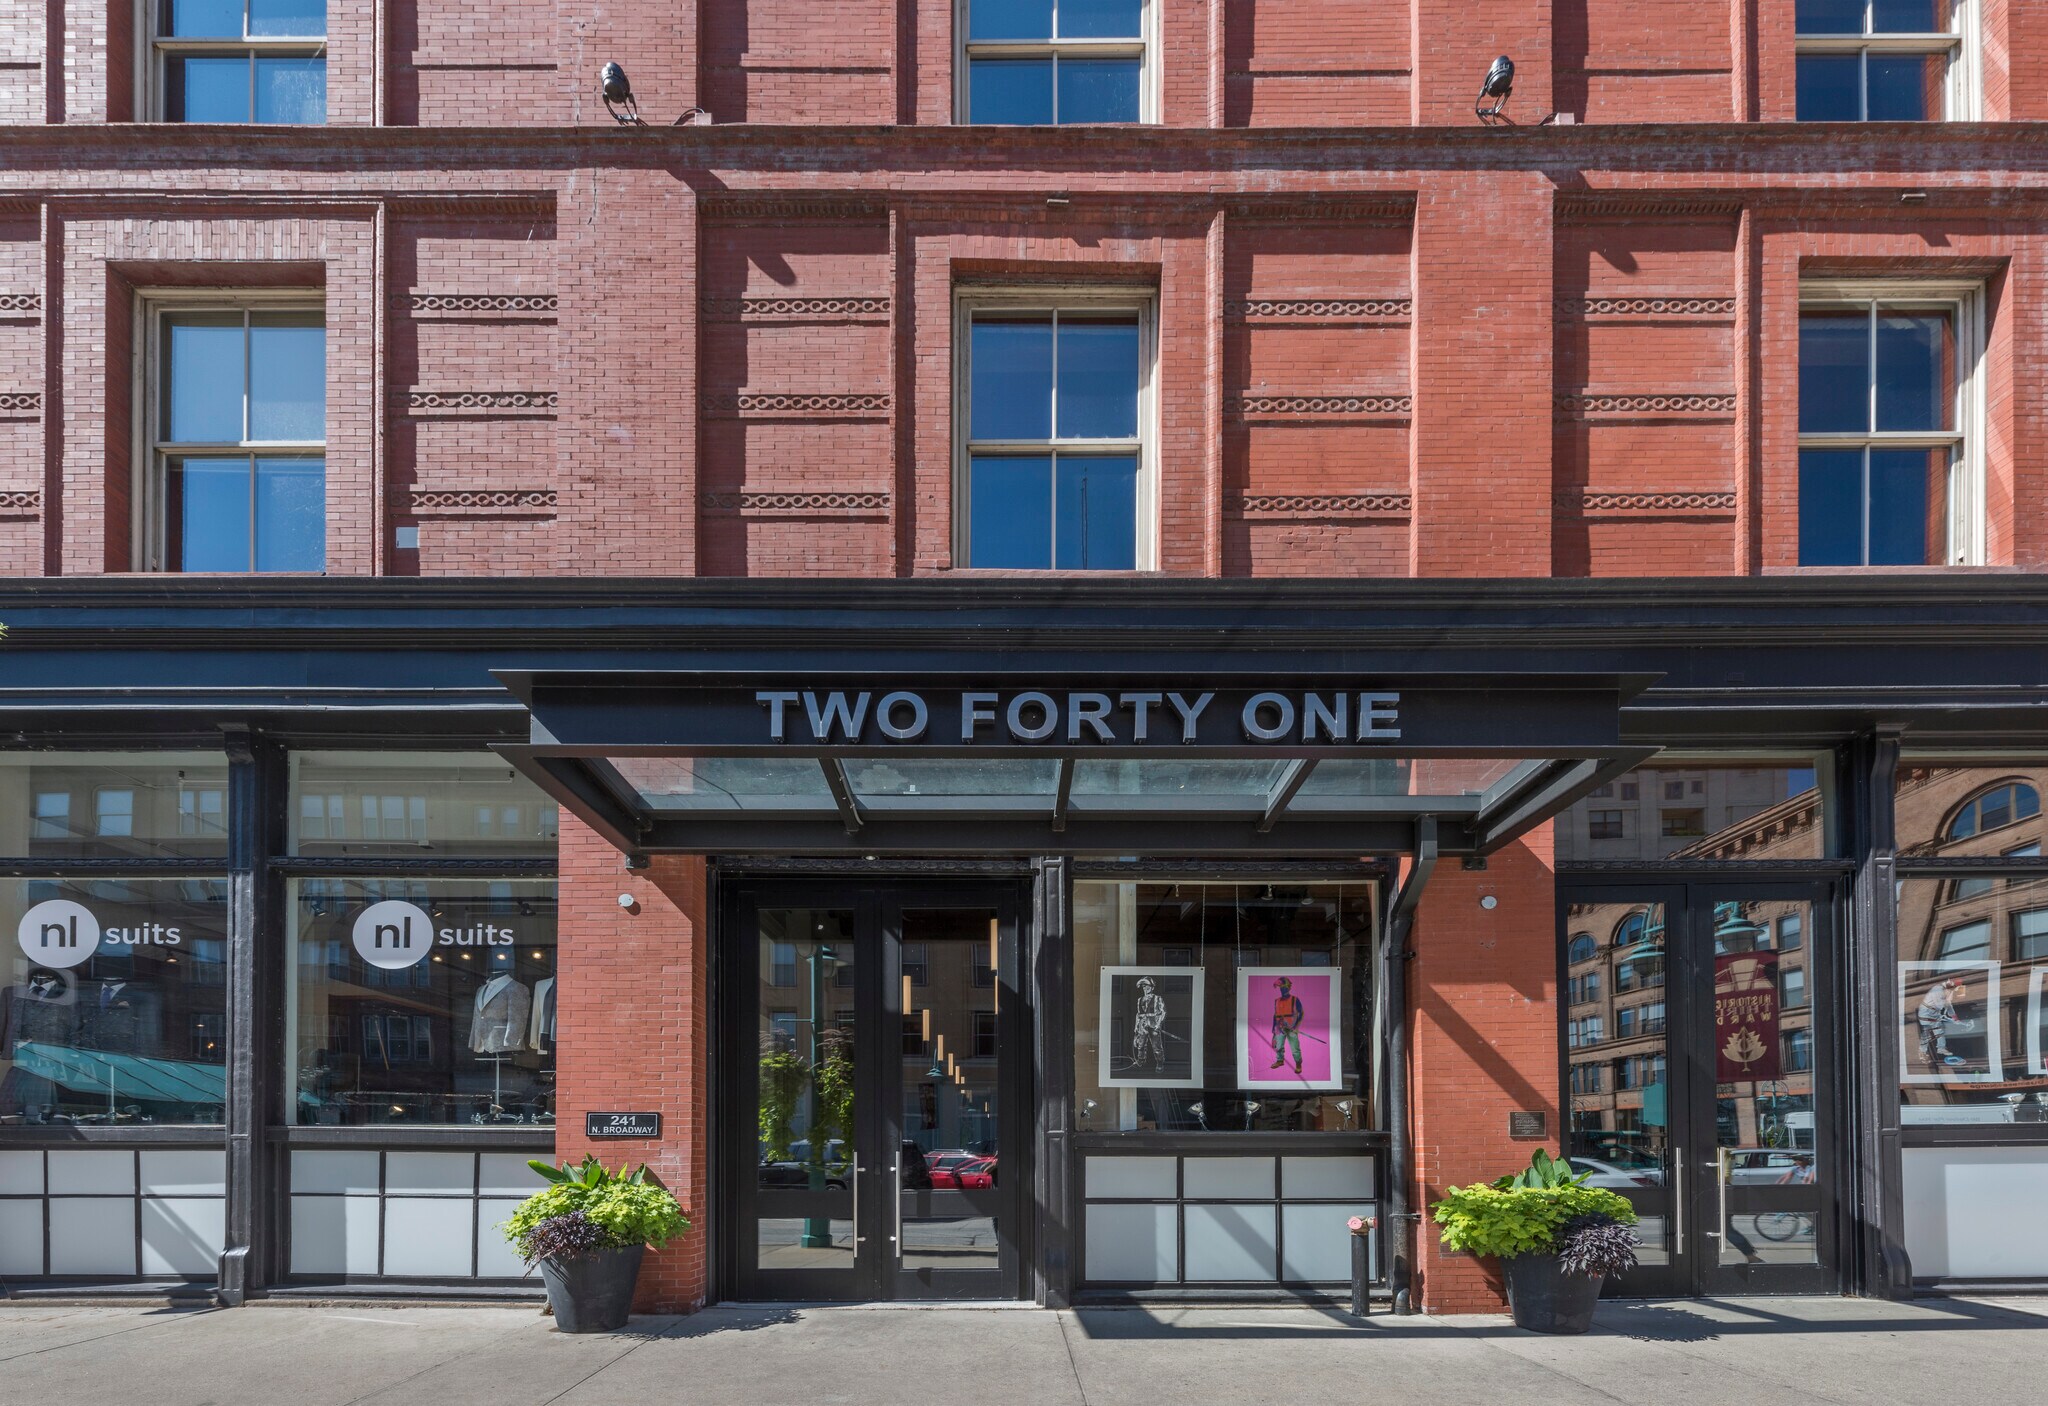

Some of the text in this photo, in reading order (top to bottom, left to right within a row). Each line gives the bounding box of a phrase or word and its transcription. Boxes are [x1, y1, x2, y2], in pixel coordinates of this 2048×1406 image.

[756, 691, 1402, 743] TWO FORTY ONE
[41, 915, 181, 948] nl suits
[375, 916, 514, 948] nl suits
[591, 1126, 653, 1134] N. BROADWAY
[610, 1115, 636, 1126] 241
